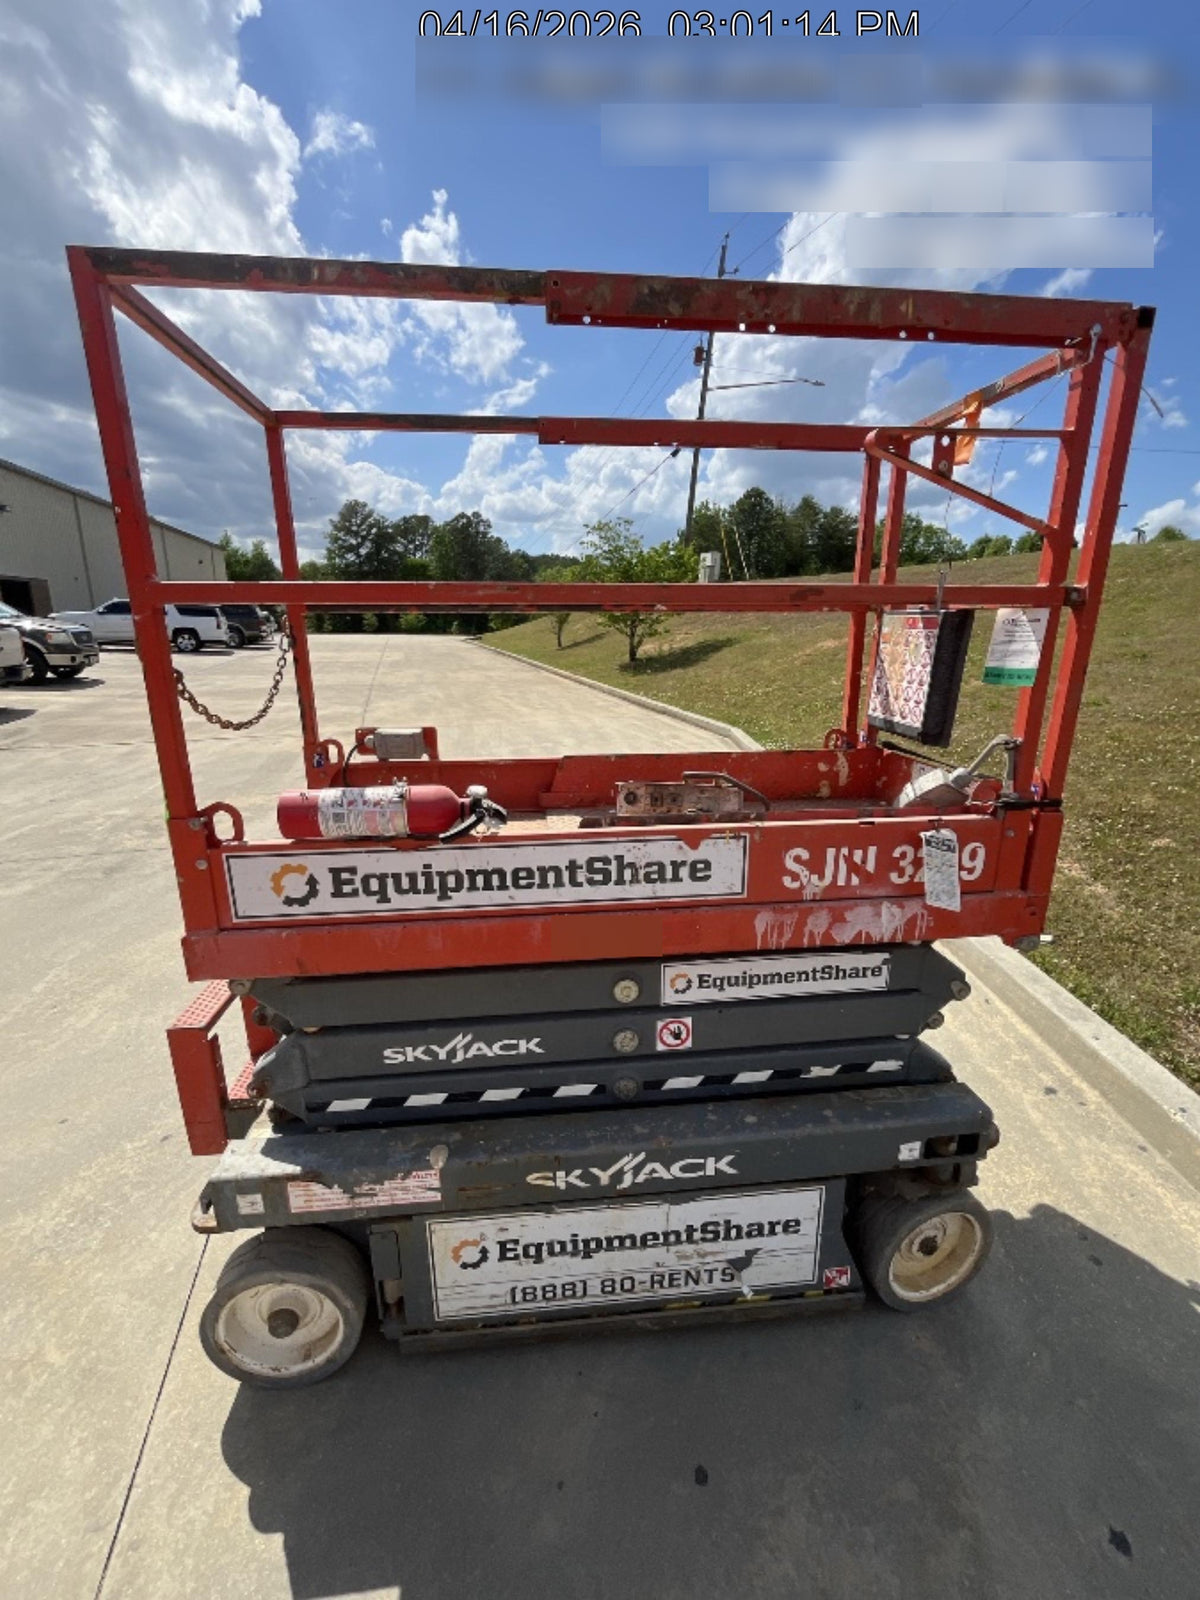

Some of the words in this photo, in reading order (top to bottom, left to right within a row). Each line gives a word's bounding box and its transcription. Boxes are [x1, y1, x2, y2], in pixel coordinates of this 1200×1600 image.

[328, 854, 712, 904] EquipmentShare
[696, 964, 884, 990] EquipmentShare
[383, 1032, 546, 1064] SKYJACK
[525, 1151, 739, 1190] SKYJACK
[496, 1216, 802, 1265] EquipmentShare
[600, 1266, 736, 1296] 80-RENTS
